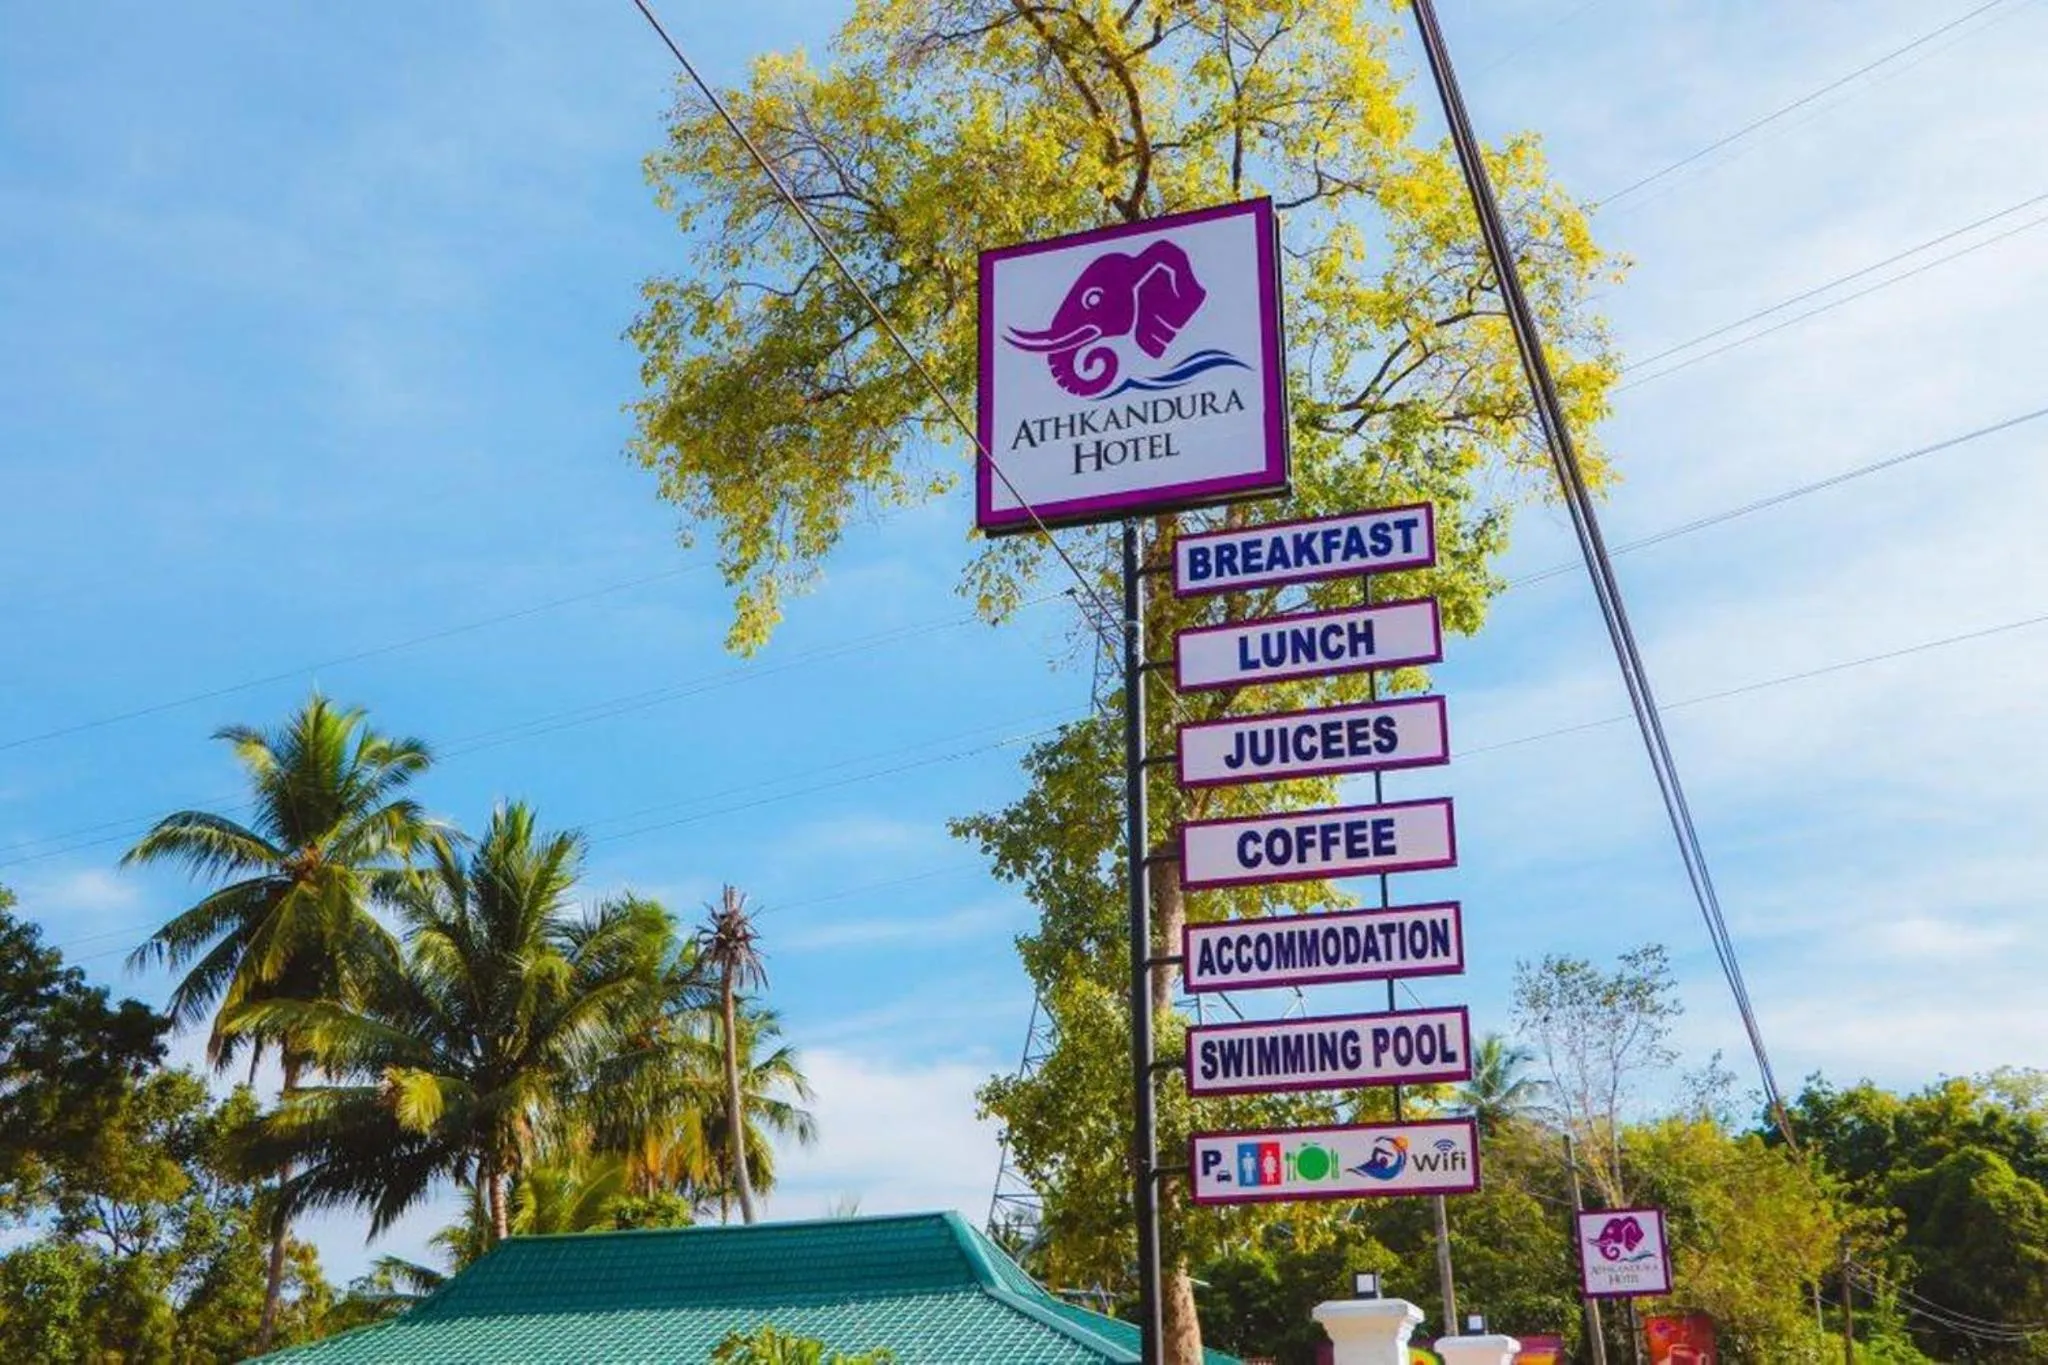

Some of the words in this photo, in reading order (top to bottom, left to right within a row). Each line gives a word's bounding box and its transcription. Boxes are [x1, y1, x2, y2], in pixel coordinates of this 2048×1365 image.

[1011, 388, 1245, 450] ATHKANDURA
[1070, 432, 1180, 475] HOTEL
[1188, 518, 1418, 581] BREAKFAST
[1238, 619, 1375, 671] LUNCH
[1224, 715, 1399, 769] JUICEES
[1236, 818, 1397, 869] COFFEE
[1197, 917, 1450, 977] ACCOMMODATION
[1200, 1029, 1361, 1080] SWIMMING
[1373, 1023, 1457, 1068] POOL
[1202, 1149, 1222, 1177] P
